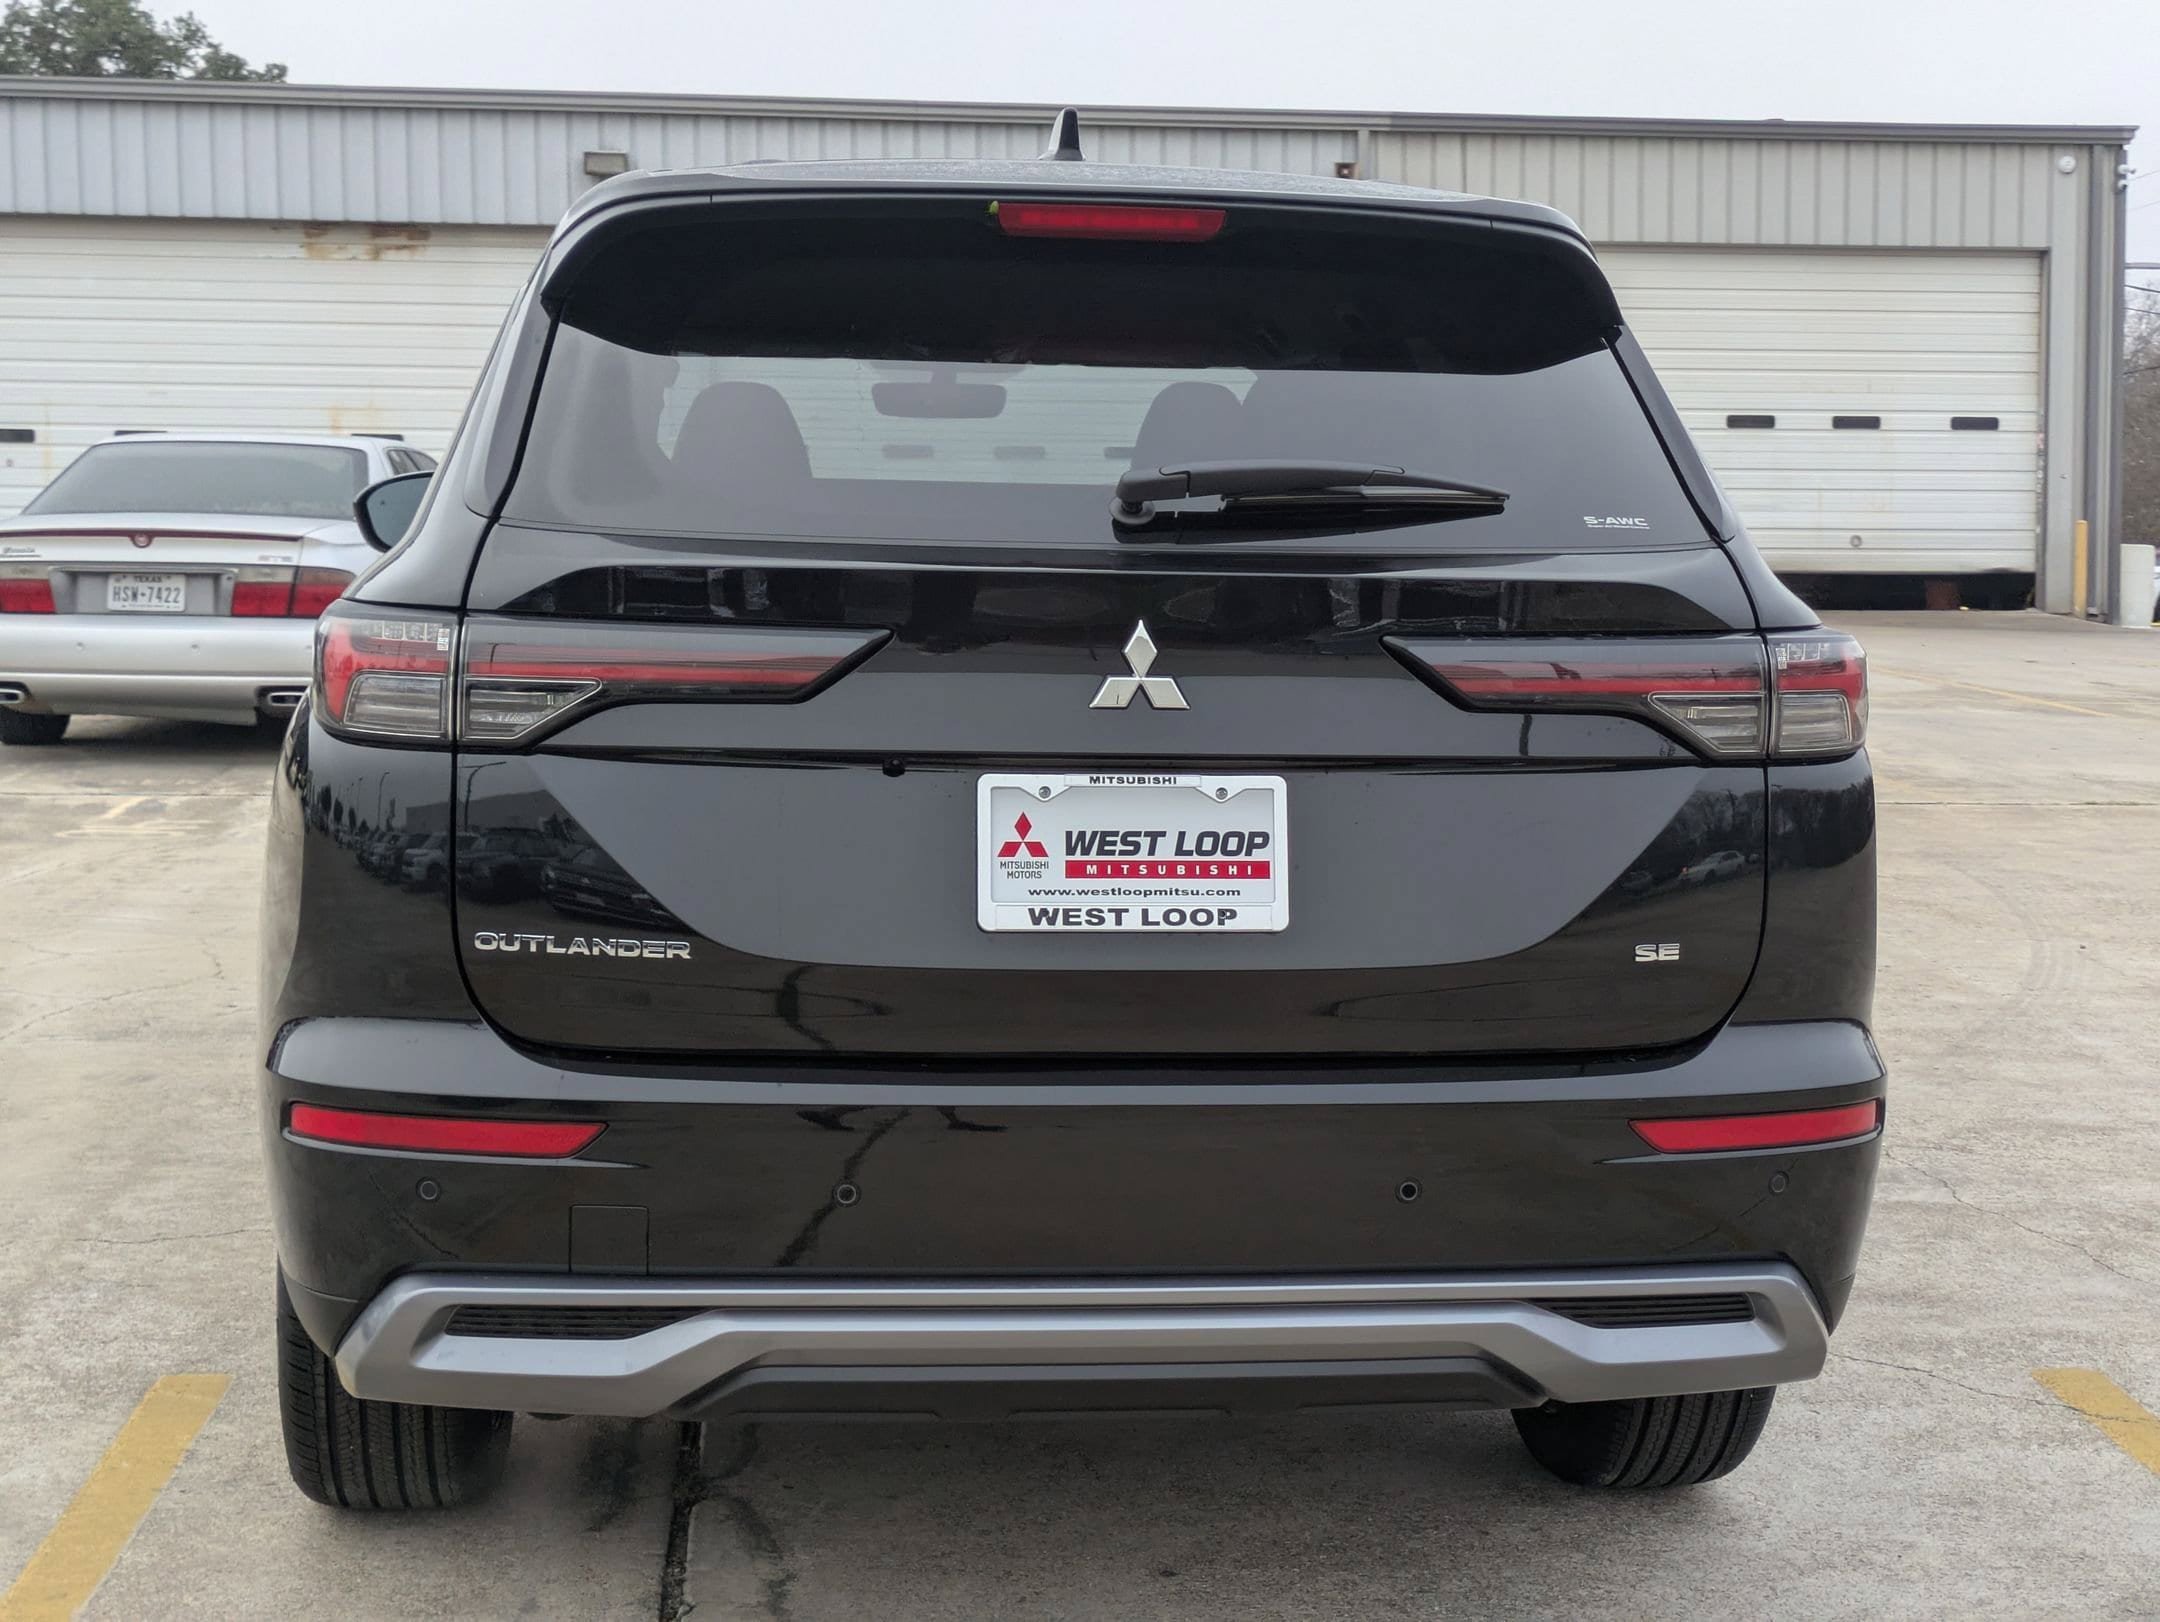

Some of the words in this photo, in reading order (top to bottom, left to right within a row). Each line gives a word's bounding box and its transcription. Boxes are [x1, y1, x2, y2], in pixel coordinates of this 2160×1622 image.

[1583, 516, 1648, 526] S-AWC
[1089, 776, 1177, 785] MITSUBISHI
[1065, 830, 1167, 857] WEST
[1174, 830, 1270, 857] LOOP
[1000, 861, 1049, 870] MITSUBISHI
[1086, 864, 1252, 876] MITSUBISHI
[1007, 870, 1042, 879] MOTORS
[1028, 887, 1241, 898] www.westloopmitsu.com
[1027, 907, 1130, 927] WEST
[1141, 907, 1238, 927] LOOP
[474, 931, 692, 960] OUTLANDER
[1635, 943, 1680, 962] SE
